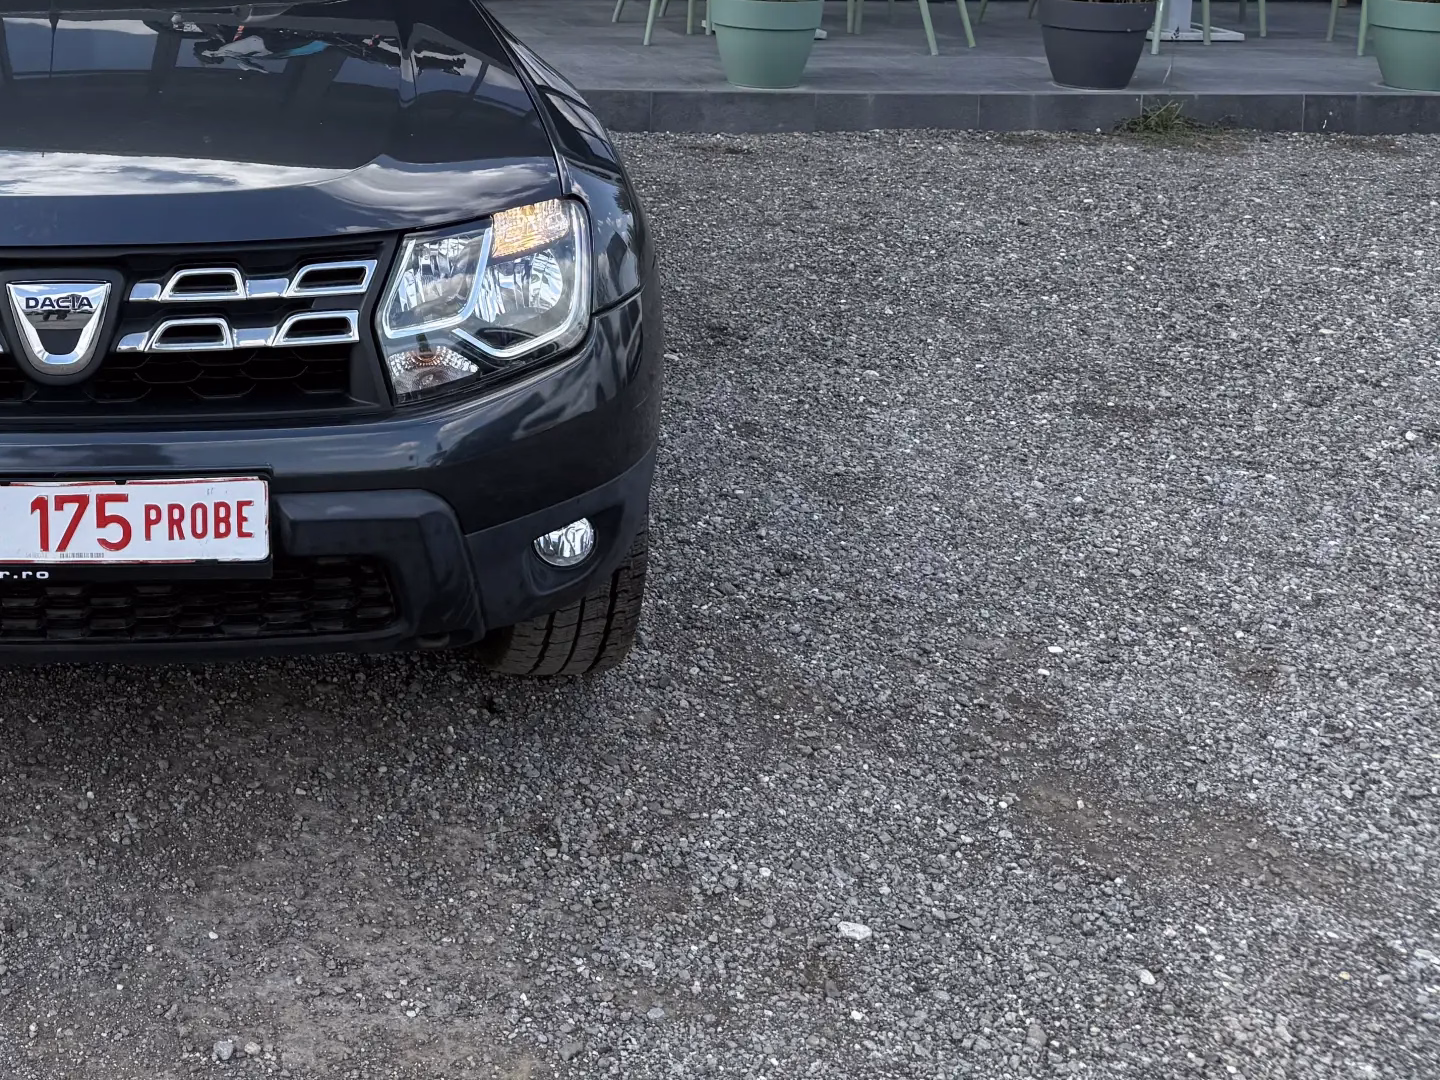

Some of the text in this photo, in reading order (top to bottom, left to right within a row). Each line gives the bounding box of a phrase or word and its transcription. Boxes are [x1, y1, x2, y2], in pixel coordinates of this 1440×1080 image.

[25, 296, 93, 310] DACIA
[30, 493, 132, 553] 175
[144, 499, 255, 542] PROBE
